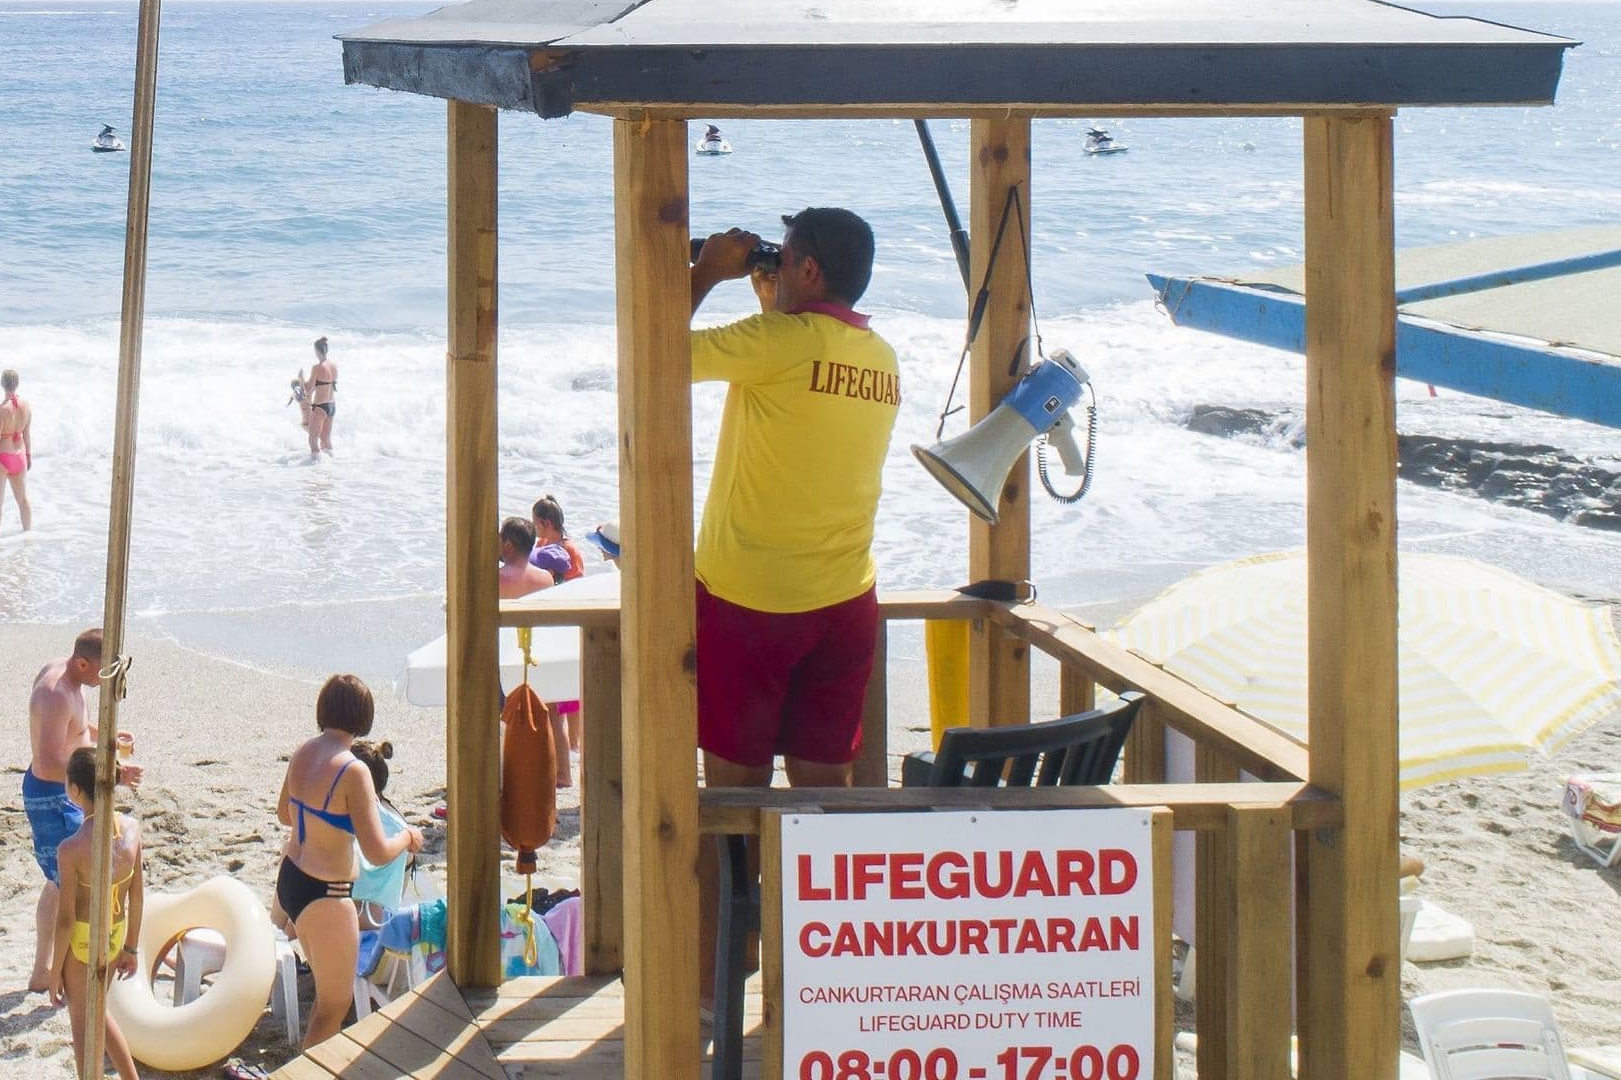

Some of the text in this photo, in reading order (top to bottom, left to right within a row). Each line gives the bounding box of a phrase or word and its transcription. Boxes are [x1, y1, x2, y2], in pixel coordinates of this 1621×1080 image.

[797, 849, 1138, 900] LIFEGUARD
[799, 916, 1139, 957] CANKURTARAN
[799, 976, 1141, 1005] CANKURTARAN ÇALIŞMA SAATLERİ
[859, 1011, 1083, 1033] LIFEGUARD DUTY TIME
[799, 1047, 959, 1080] 08:00
[997, 1044, 1141, 1080] 17:00
